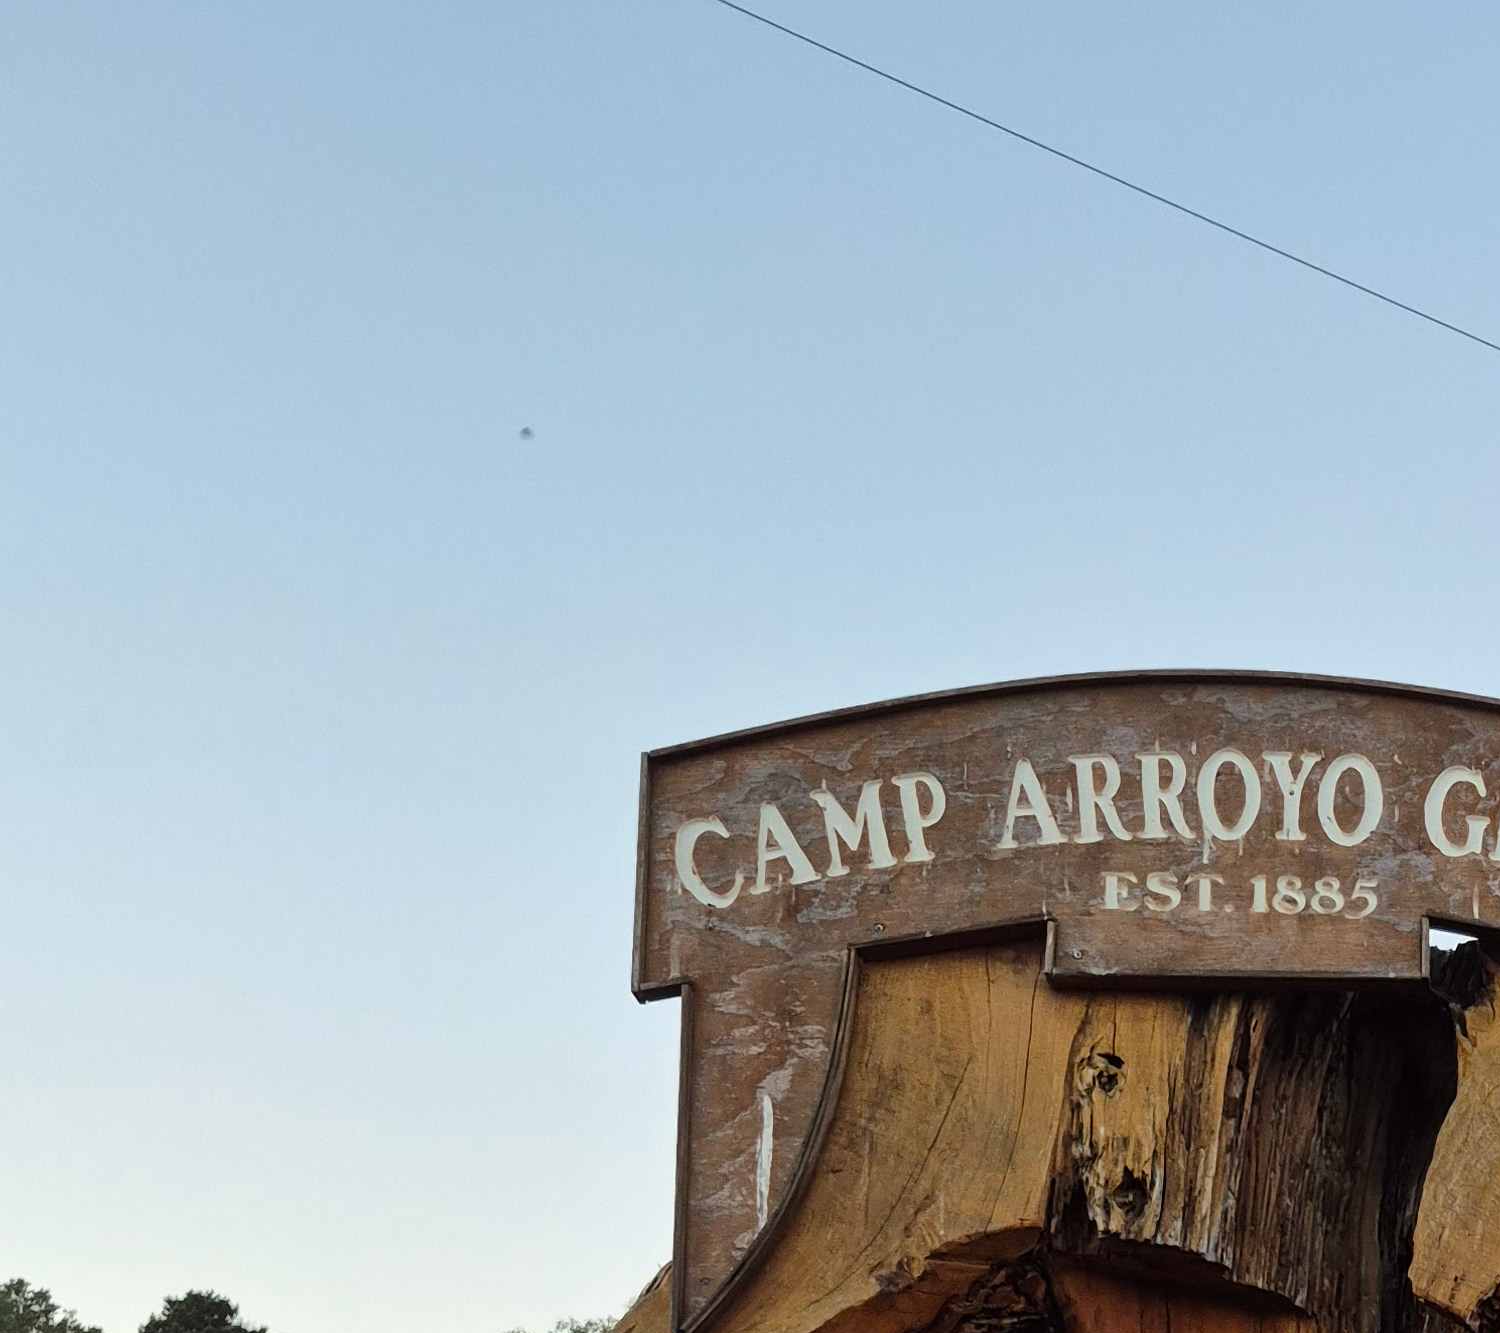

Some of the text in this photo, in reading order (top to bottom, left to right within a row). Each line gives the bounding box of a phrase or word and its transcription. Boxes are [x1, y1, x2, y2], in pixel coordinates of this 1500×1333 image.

[675, 771, 946, 909] CAMP
[997, 747, 1384, 849] ARROYO
[1100, 871, 1378, 919] EST. 1885
